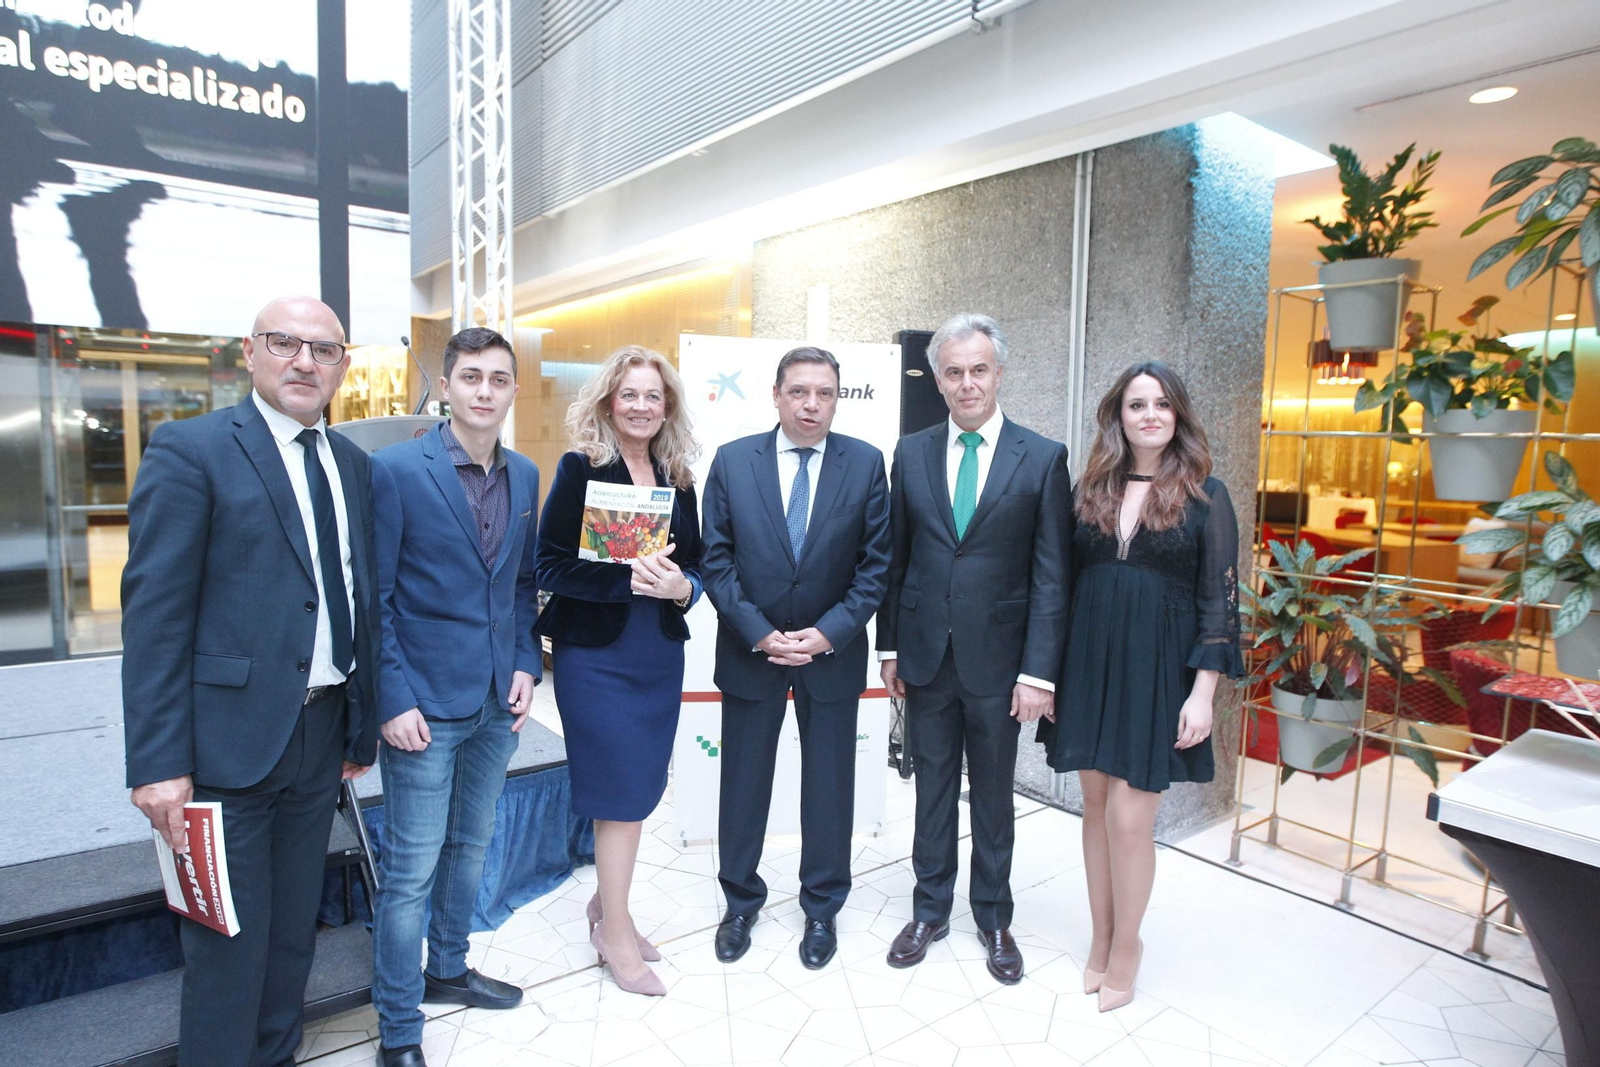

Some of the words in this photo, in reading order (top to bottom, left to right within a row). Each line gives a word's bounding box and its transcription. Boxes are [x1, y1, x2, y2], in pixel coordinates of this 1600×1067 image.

[44, 46, 306, 123] especializado
[838, 383, 875, 400] ank
[593, 490, 636, 499] AGRICULTURA
[653, 494, 668, 502] 2019
[182, 820, 209, 917] vertir
[203, 817, 218, 898] FINANCIACIÓN
